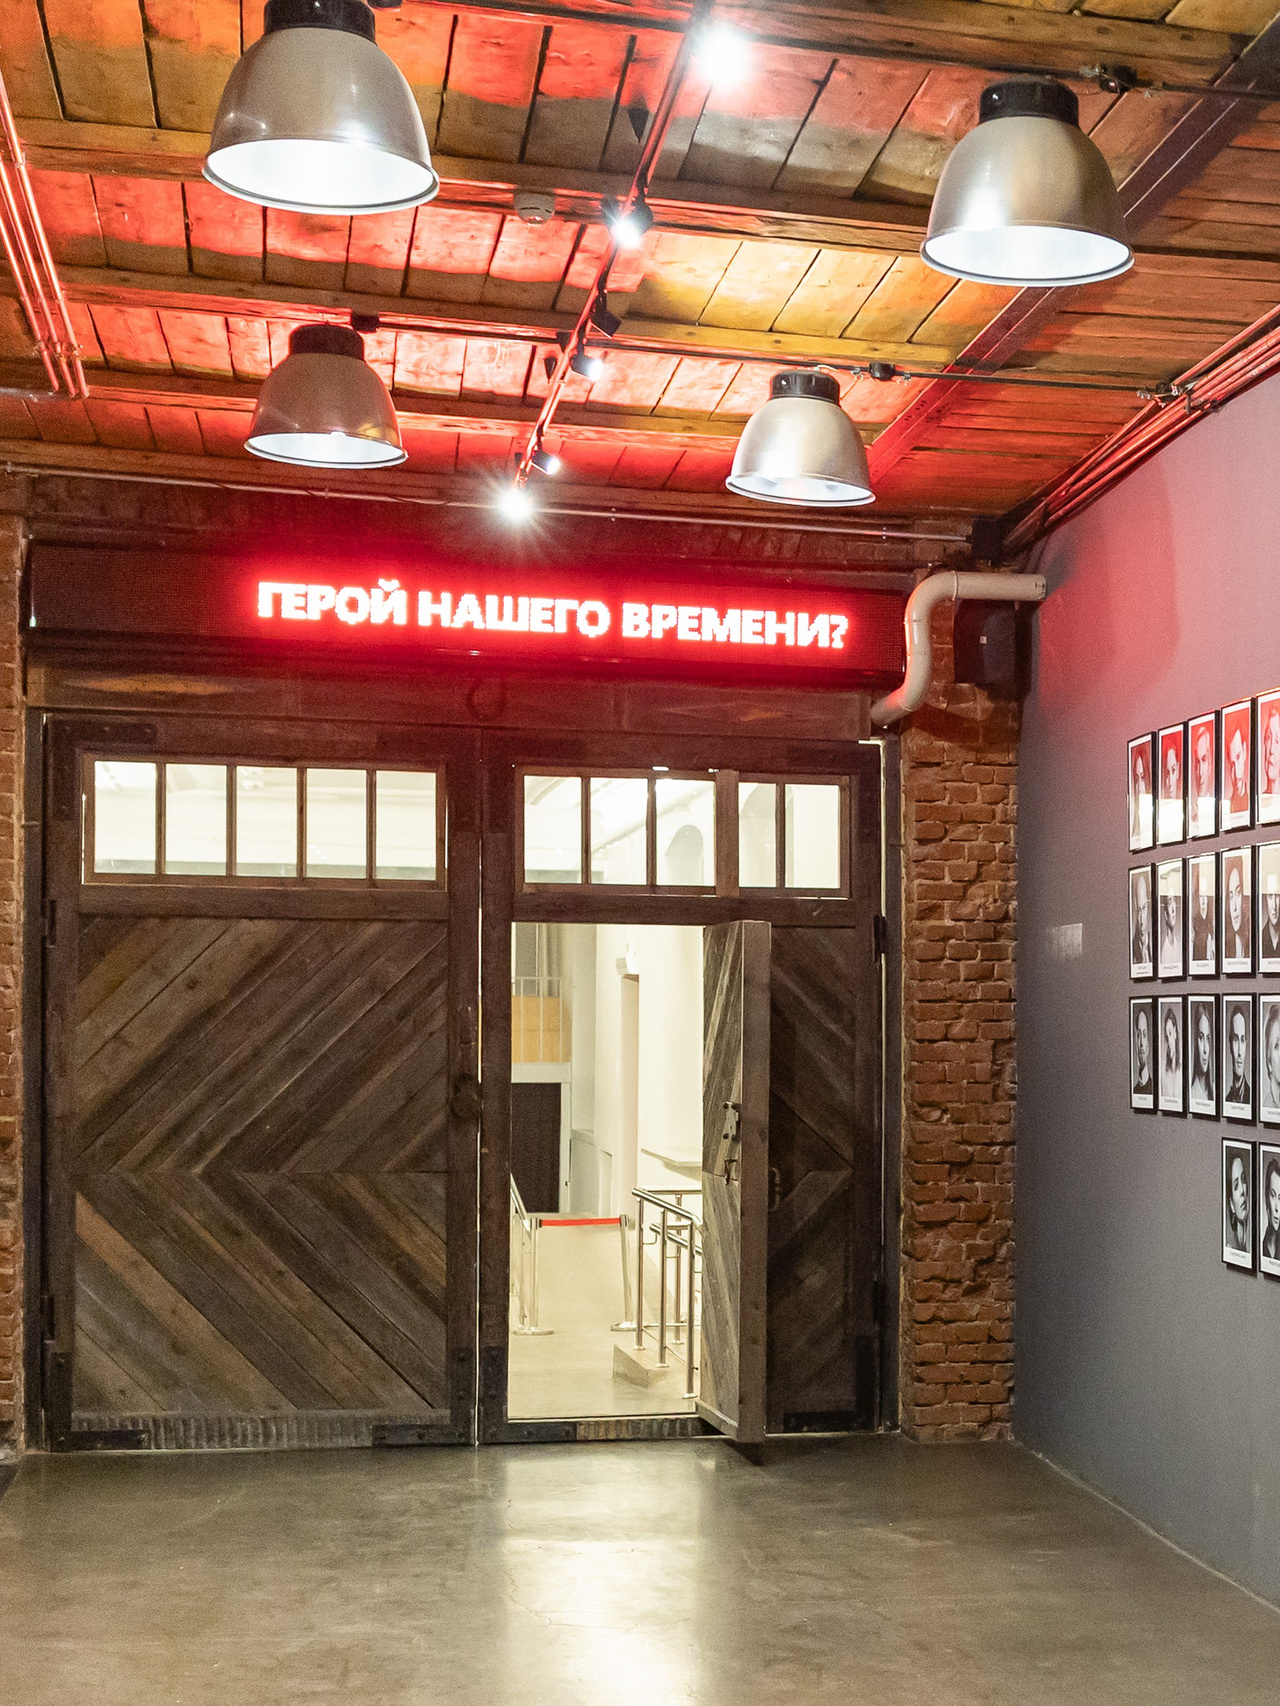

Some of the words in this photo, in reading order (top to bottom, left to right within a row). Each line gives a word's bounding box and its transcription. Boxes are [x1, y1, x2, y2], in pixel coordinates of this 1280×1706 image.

[257, 579, 402, 625] ГЕРОЙ
[417, 590, 611, 638] НАШЕГО
[621, 602, 848, 649] ВРЕМЕНИ?
